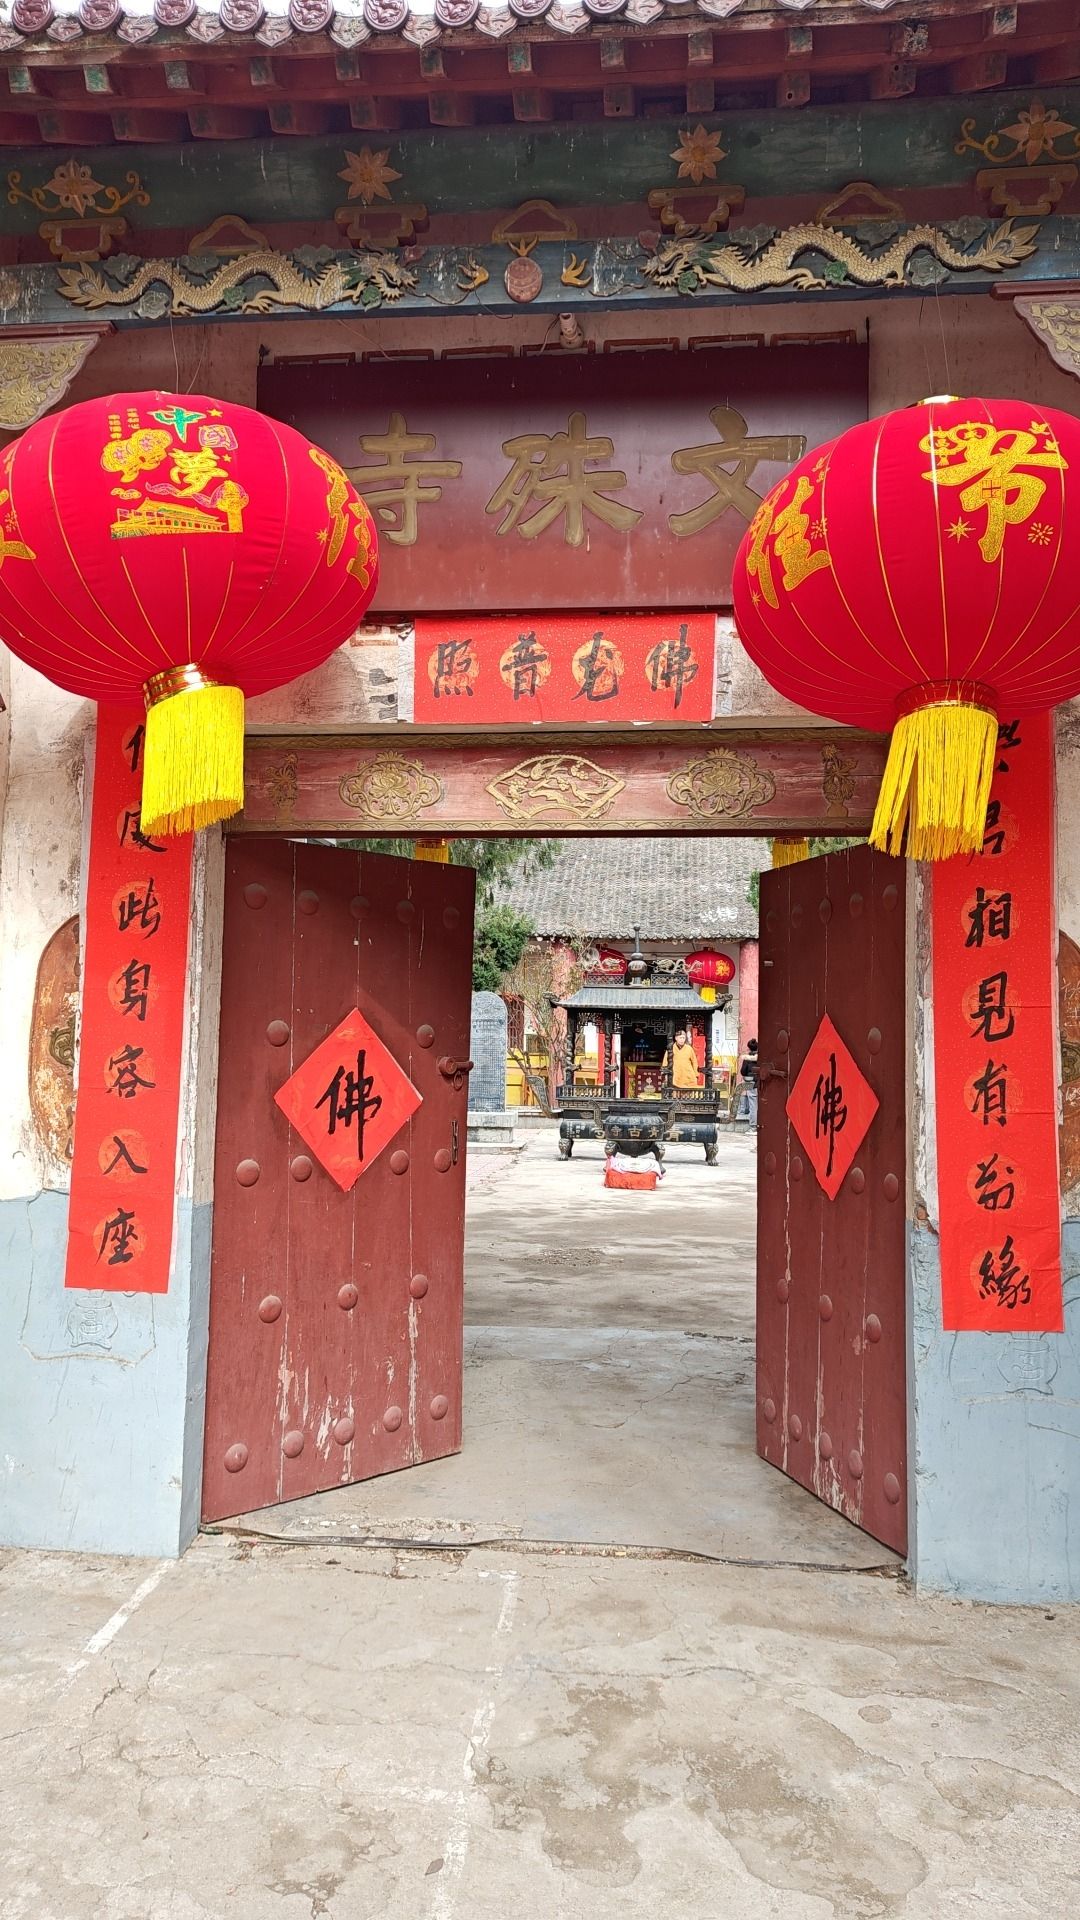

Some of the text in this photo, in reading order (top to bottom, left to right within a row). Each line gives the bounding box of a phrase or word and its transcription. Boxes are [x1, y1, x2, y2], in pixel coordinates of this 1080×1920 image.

[433, 624, 698, 709] 佛光普照
[314, 1049, 383, 1162] 佛
[811, 1053, 848, 1177] 佛
